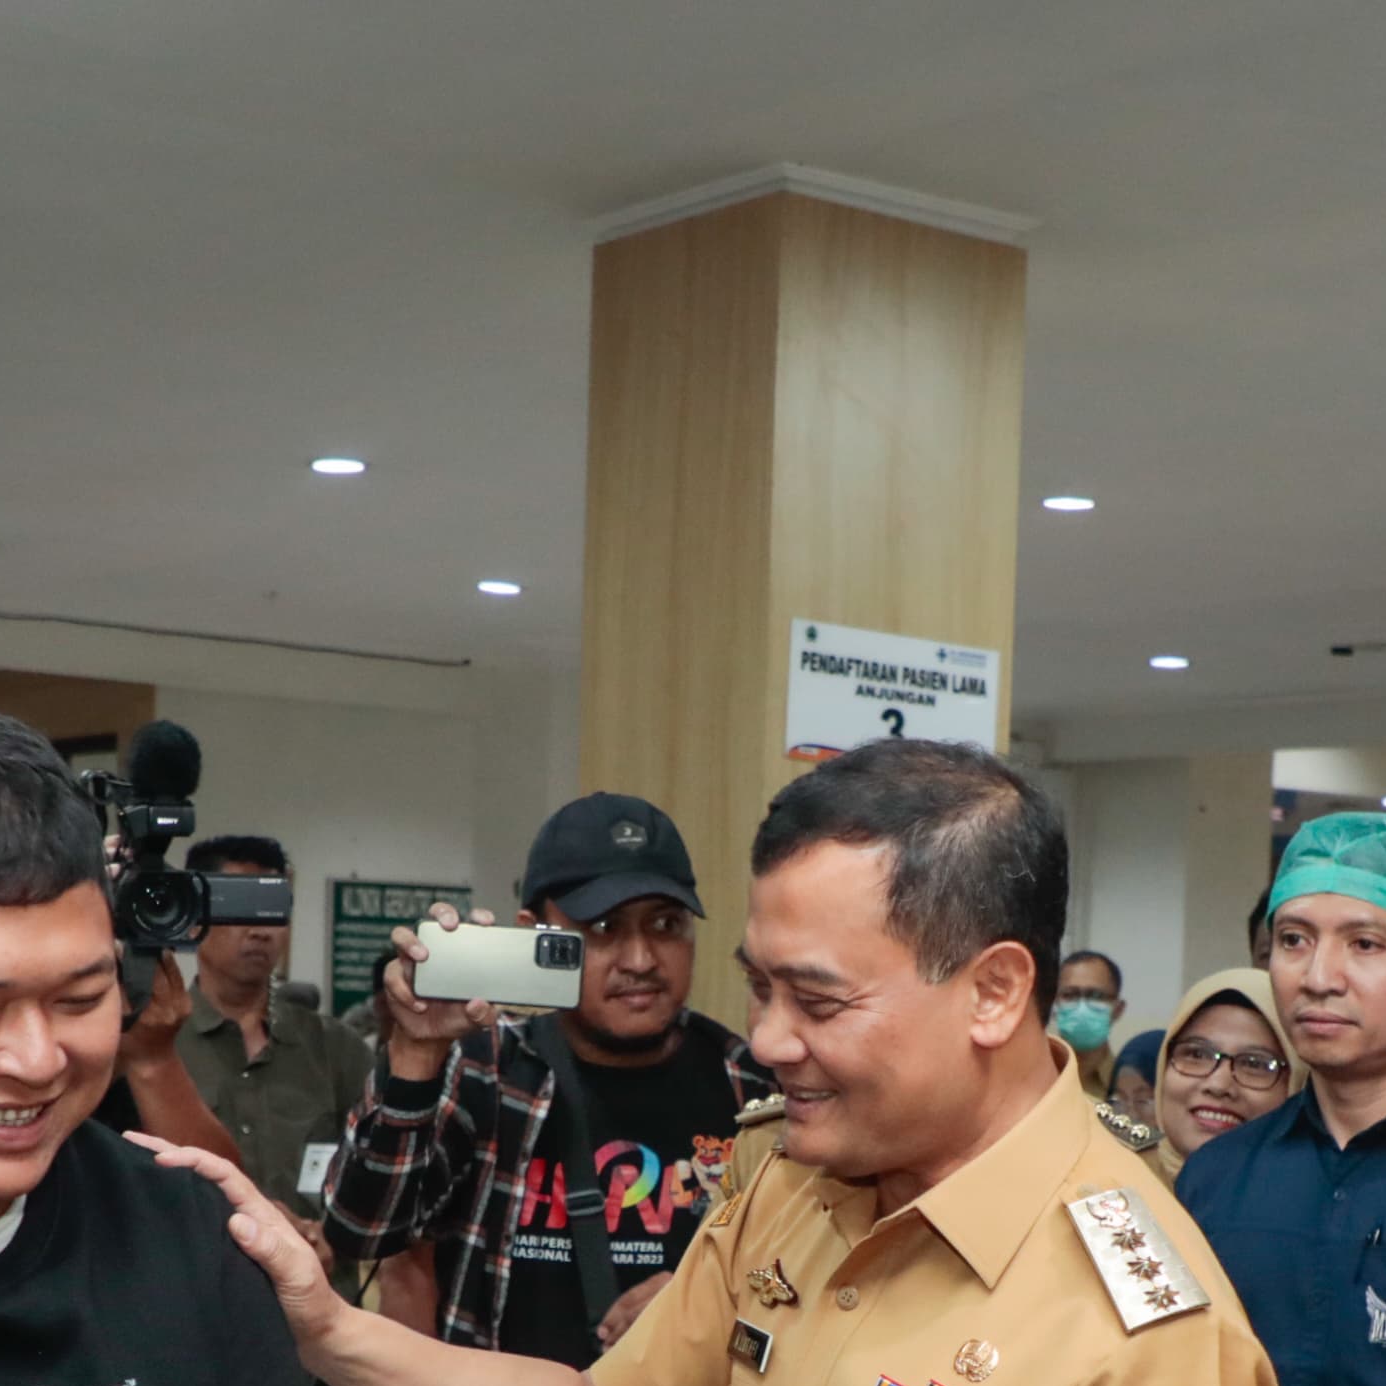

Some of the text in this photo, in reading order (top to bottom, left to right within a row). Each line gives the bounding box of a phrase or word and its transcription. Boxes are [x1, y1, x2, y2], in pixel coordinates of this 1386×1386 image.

[800, 650, 987, 697] PENDAFTARAN PASIEN LAMA
[855, 683, 936, 707] ANJUNGAN
[540, 1236, 573, 1251] PERS
[635, 1254, 664, 1265] 2023
